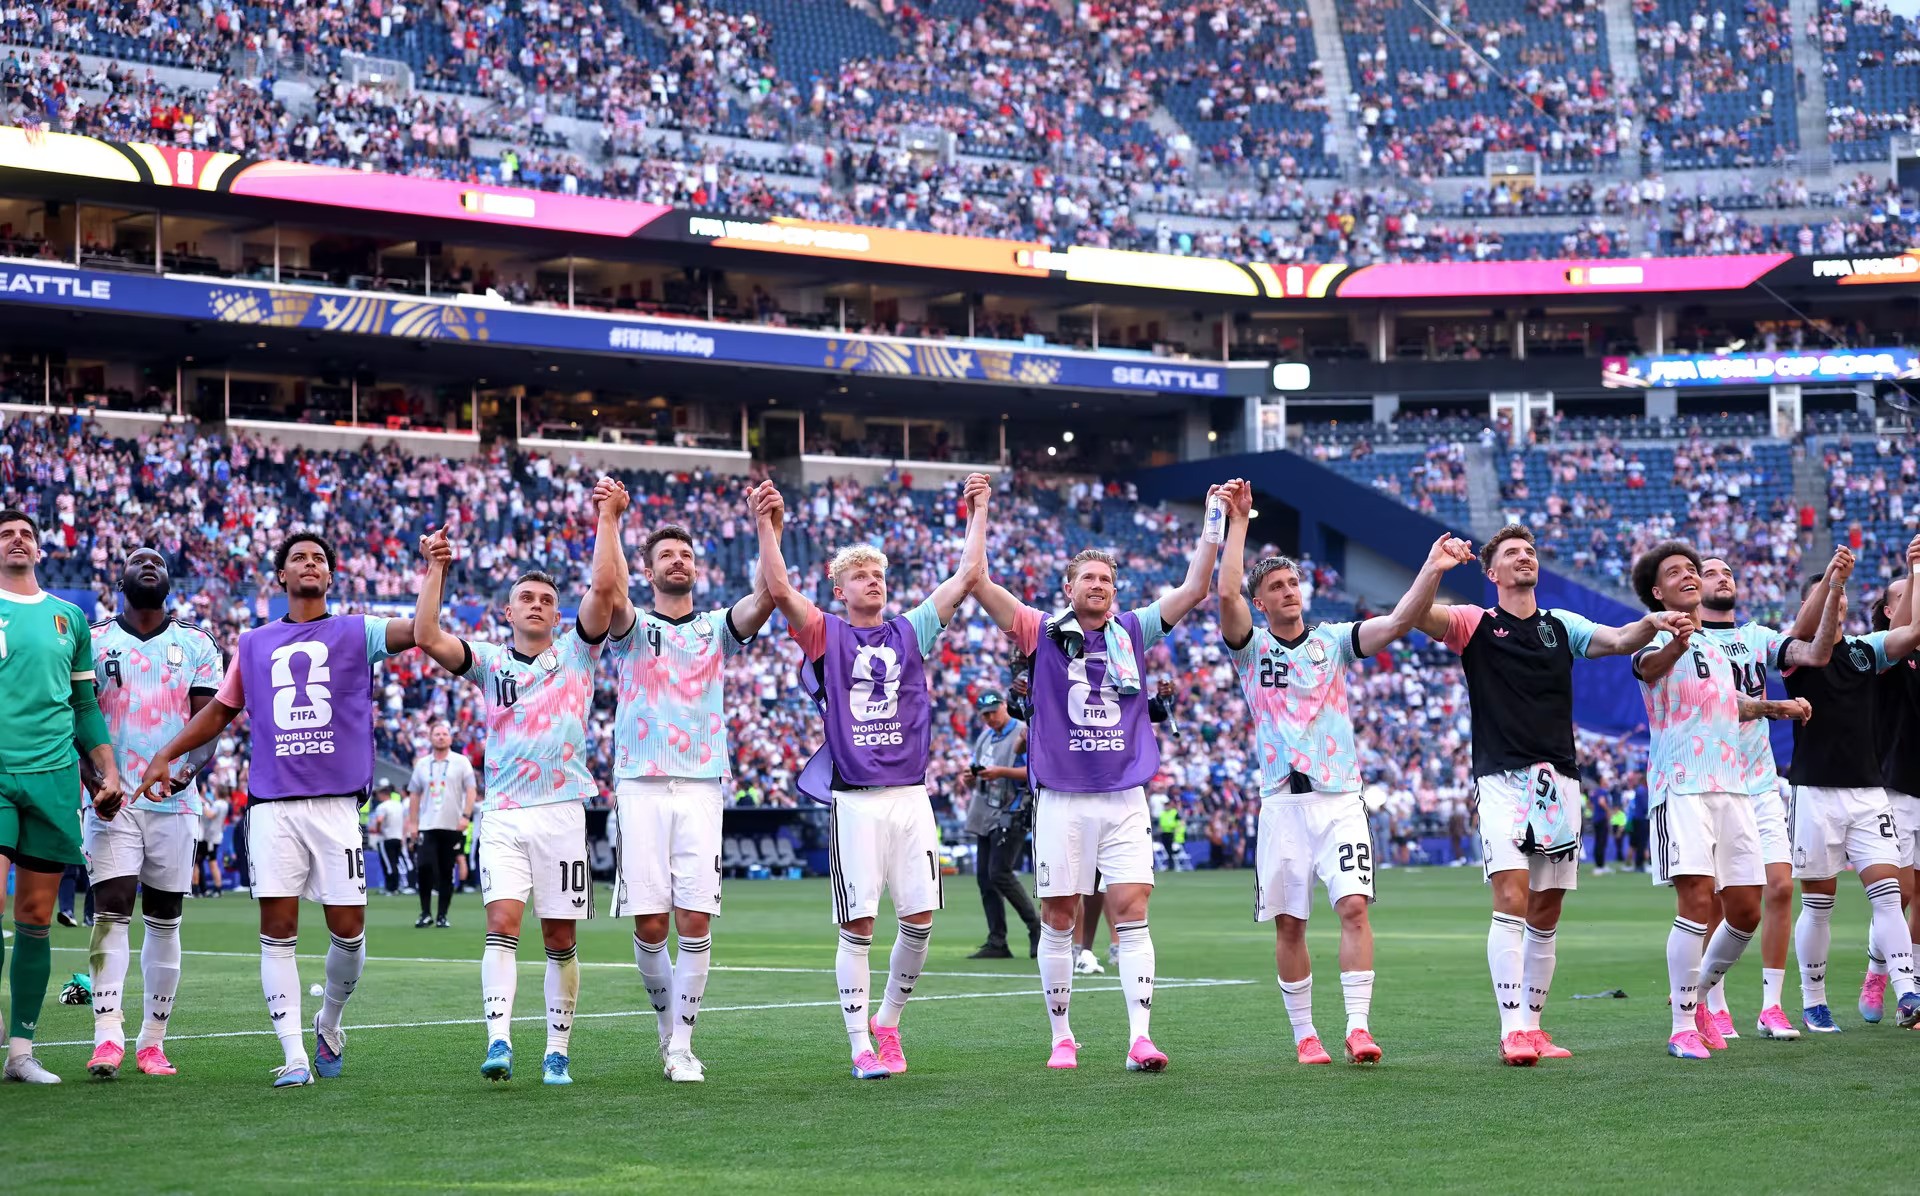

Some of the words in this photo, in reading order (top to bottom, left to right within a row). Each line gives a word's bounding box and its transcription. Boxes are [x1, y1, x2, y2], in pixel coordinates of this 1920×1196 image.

[1697, 358, 1775, 378] WORLD
[1775, 356, 1819, 376] CUP
[1112, 366, 1219, 390] SEATTLE
[647, 630, 661, 657] 4
[105, 660, 122, 688] 9
[1260, 658, 1288, 688] 22
[1693, 651, 1710, 678] 6
[495, 676, 518, 708] 10
[290, 710, 317, 721] FIFA
[866, 702, 889, 713] FIFA
[1083, 708, 1107, 719] FIFA
[275, 732, 312, 742] WORLD
[314, 731, 334, 739] CUP
[852, 723, 883, 733] WORLD
[884, 722, 901, 730] CUP
[1069, 729, 1103, 738] WORLD
[1104, 729, 1124, 737] CUP
[853, 732, 903, 746] 2026
[1069, 739, 1125, 751] 2026
[275, 741, 335, 757] 2026
[1877, 813, 1898, 839] 2
[345, 848, 364, 879] 16
[927, 850, 937, 880] 1
[1339, 843, 1370, 872] 22
[560, 860, 585, 892] 10
[1680, 984, 1699, 992] RBF
[153, 994, 175, 1003] RBF
[681, 993, 703, 1003] RBF
